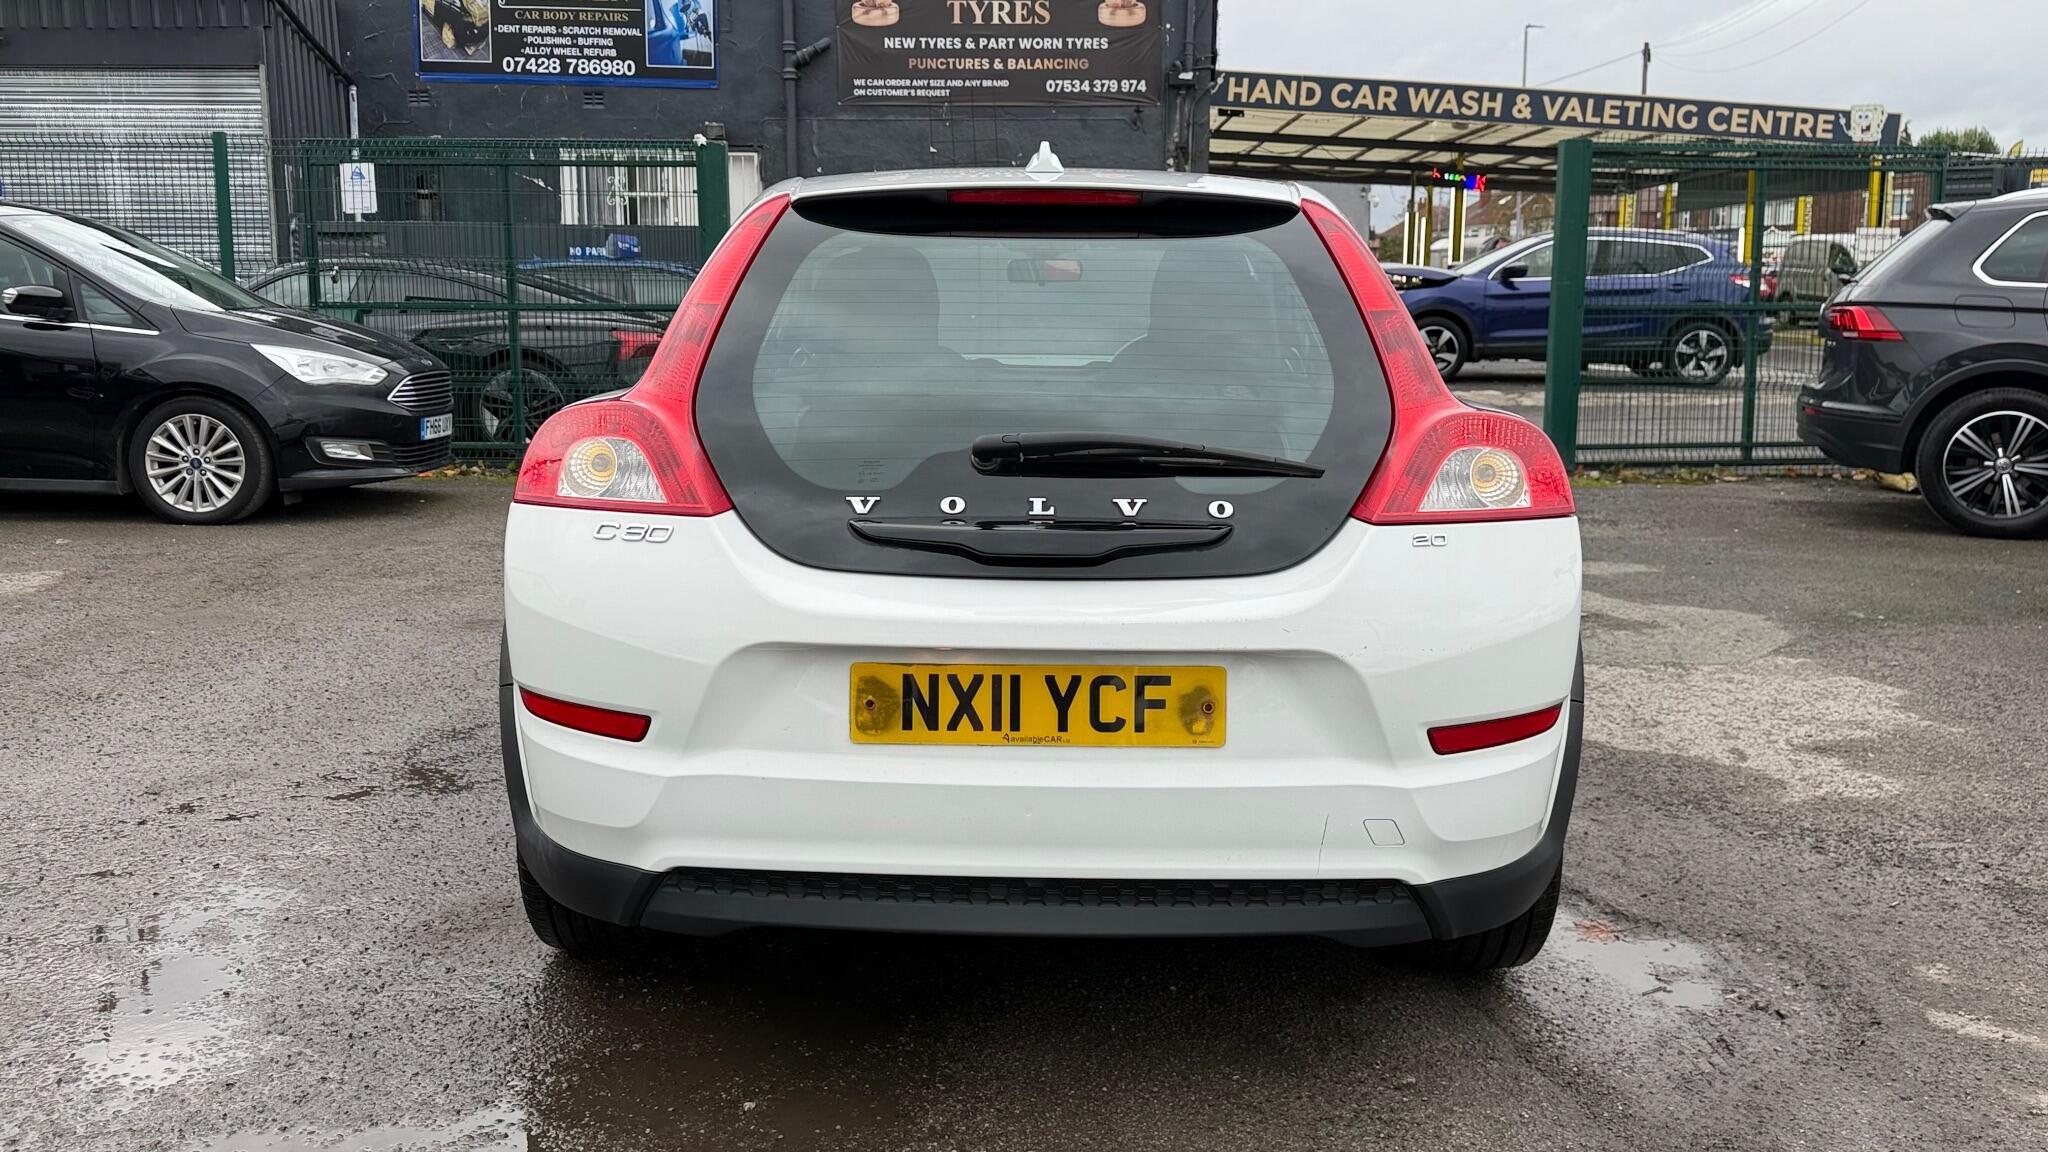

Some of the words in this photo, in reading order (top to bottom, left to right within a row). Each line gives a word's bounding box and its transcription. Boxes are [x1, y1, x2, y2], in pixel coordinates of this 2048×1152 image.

[515, 10, 540, 20] CAR
[543, 11, 576, 21] BODY
[579, 12, 629, 22] REPAIRS
[947, 0, 1051, 25] TYRES
[498, 25, 520, 33] DENT
[522, 26, 557, 34] REPAIRS
[562, 26, 601, 35] SCRATCH
[603, 27, 642, 36] REMOVAL
[527, 36, 572, 45] POLISHING
[577, 38, 613, 46] BUFFING
[884, 37, 916, 49] NEW
[919, 37, 962, 50] TYRES
[964, 37, 975, 50] &
[979, 38, 1015, 50] PART
[1019, 38, 1062, 50] WORN
[1065, 38, 1109, 50] TYRES
[524, 47, 551, 55] ALLOY
[553, 47, 582, 56] WHEEL
[583, 48, 617, 57] REFURB
[502, 57, 561, 74] 07428
[565, 58, 636, 76] 786980
[908, 58, 990, 70] PUNCTURES
[993, 58, 1004, 70] &
[1007, 58, 1089, 71] BALANCING
[853, 78, 866, 87] WE
[867, 78, 884, 87] CAN
[885, 79, 911, 87] ORDER
[912, 79, 928, 87] ANY
[930, 79, 945, 87] SIZE
[946, 79, 963, 87] AND
[965, 79, 981, 87] ANY
[982, 79, 1009, 87] BRAND
[1046, 79, 1090, 93] 07534
[1093, 79, 1118, 93] 379
[1120, 79, 1147, 93] 974
[853, 88, 865, 96] ON
[866, 89, 915, 97] CUSTOMER'S
[917, 89, 950, 98] REQUEST
[1227, 76, 1322, 107] HAND
[1331, 82, 1398, 112] CAR
[1407, 86, 1503, 118] WASH
[1511, 94, 1532, 120] &
[1542, 95, 1699, 130] VALETING
[1707, 106, 1836, 140] CENTRE
[569, 246, 582, 256] NO
[846, 496, 1235, 519] VOLVO
[593, 521, 674, 543] C30
[902, 673, 1021, 732] NX11
[1044, 675, 1172, 734] YCF
